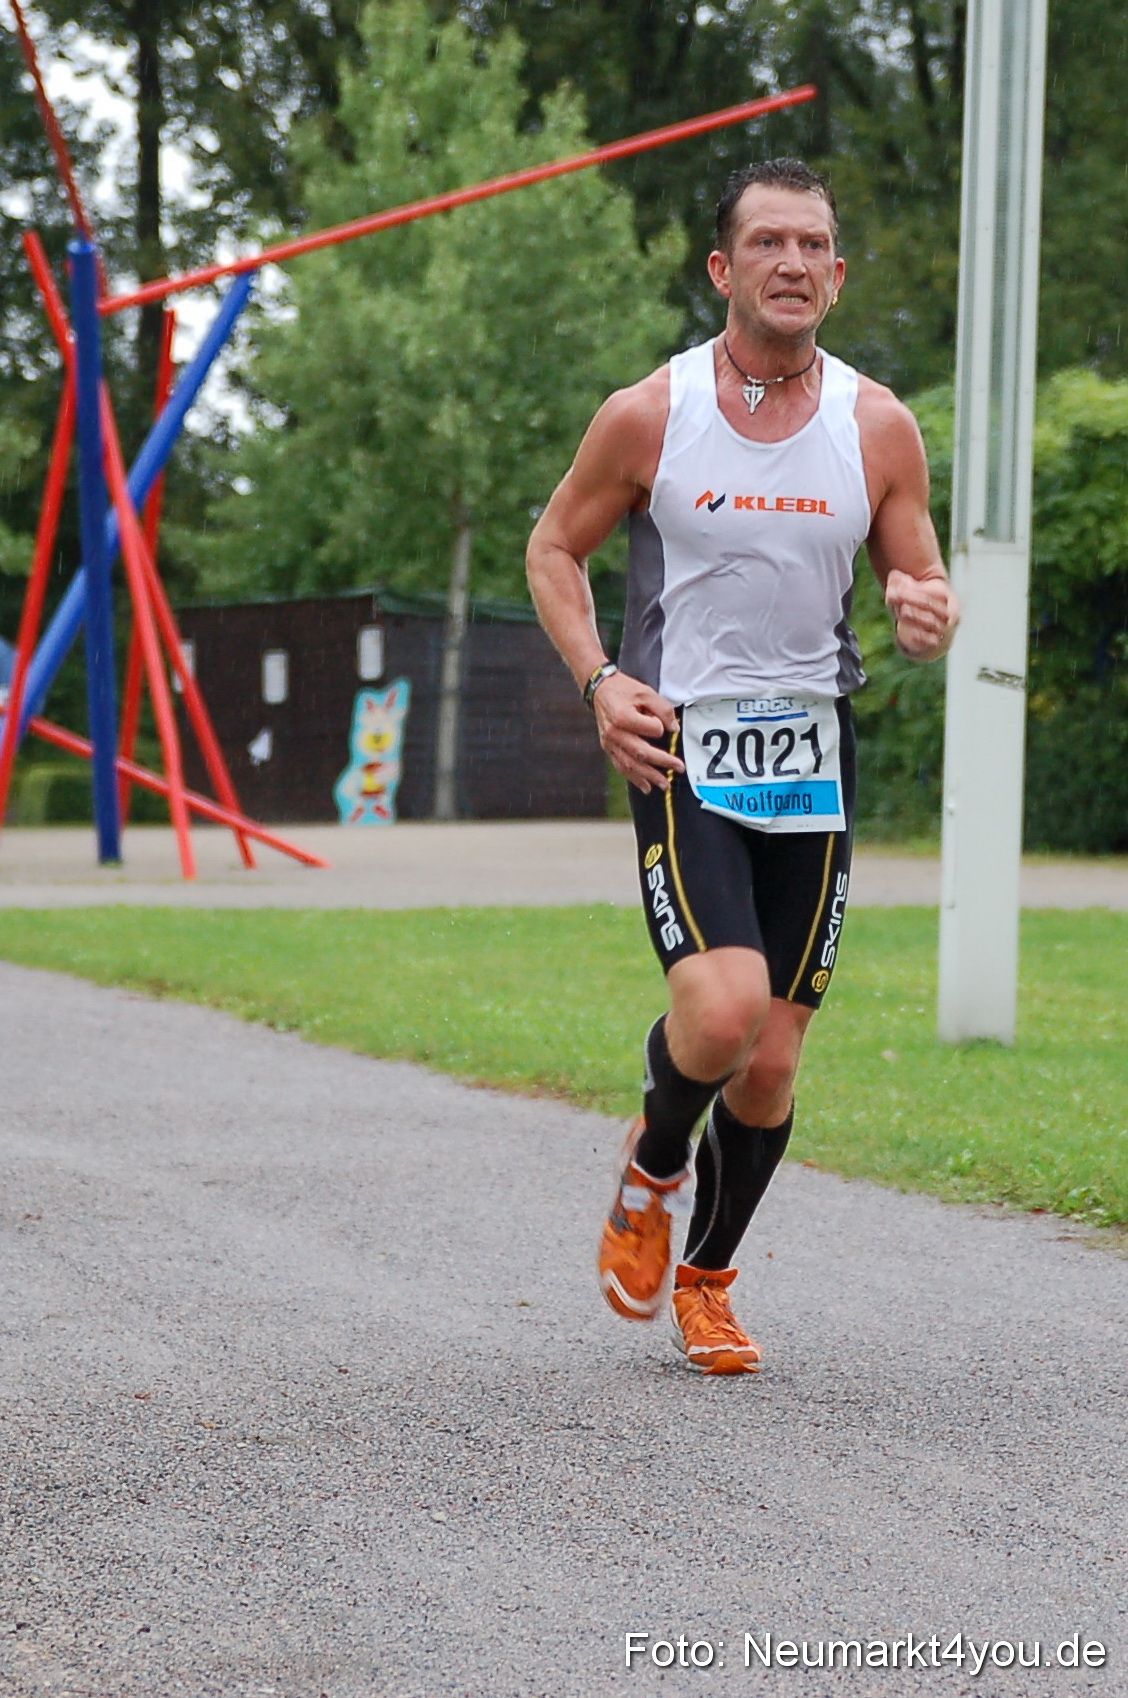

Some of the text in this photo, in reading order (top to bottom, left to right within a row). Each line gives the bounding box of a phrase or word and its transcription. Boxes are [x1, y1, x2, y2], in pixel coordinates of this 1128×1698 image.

[734, 496, 835, 516] KLEBL
[737, 697, 795, 713] BOCK
[702, 723, 823, 780] 2021
[724, 791, 813, 815] Wolfgang
[647, 863, 685, 951] SKINS
[820, 871, 848, 969] SKINS
